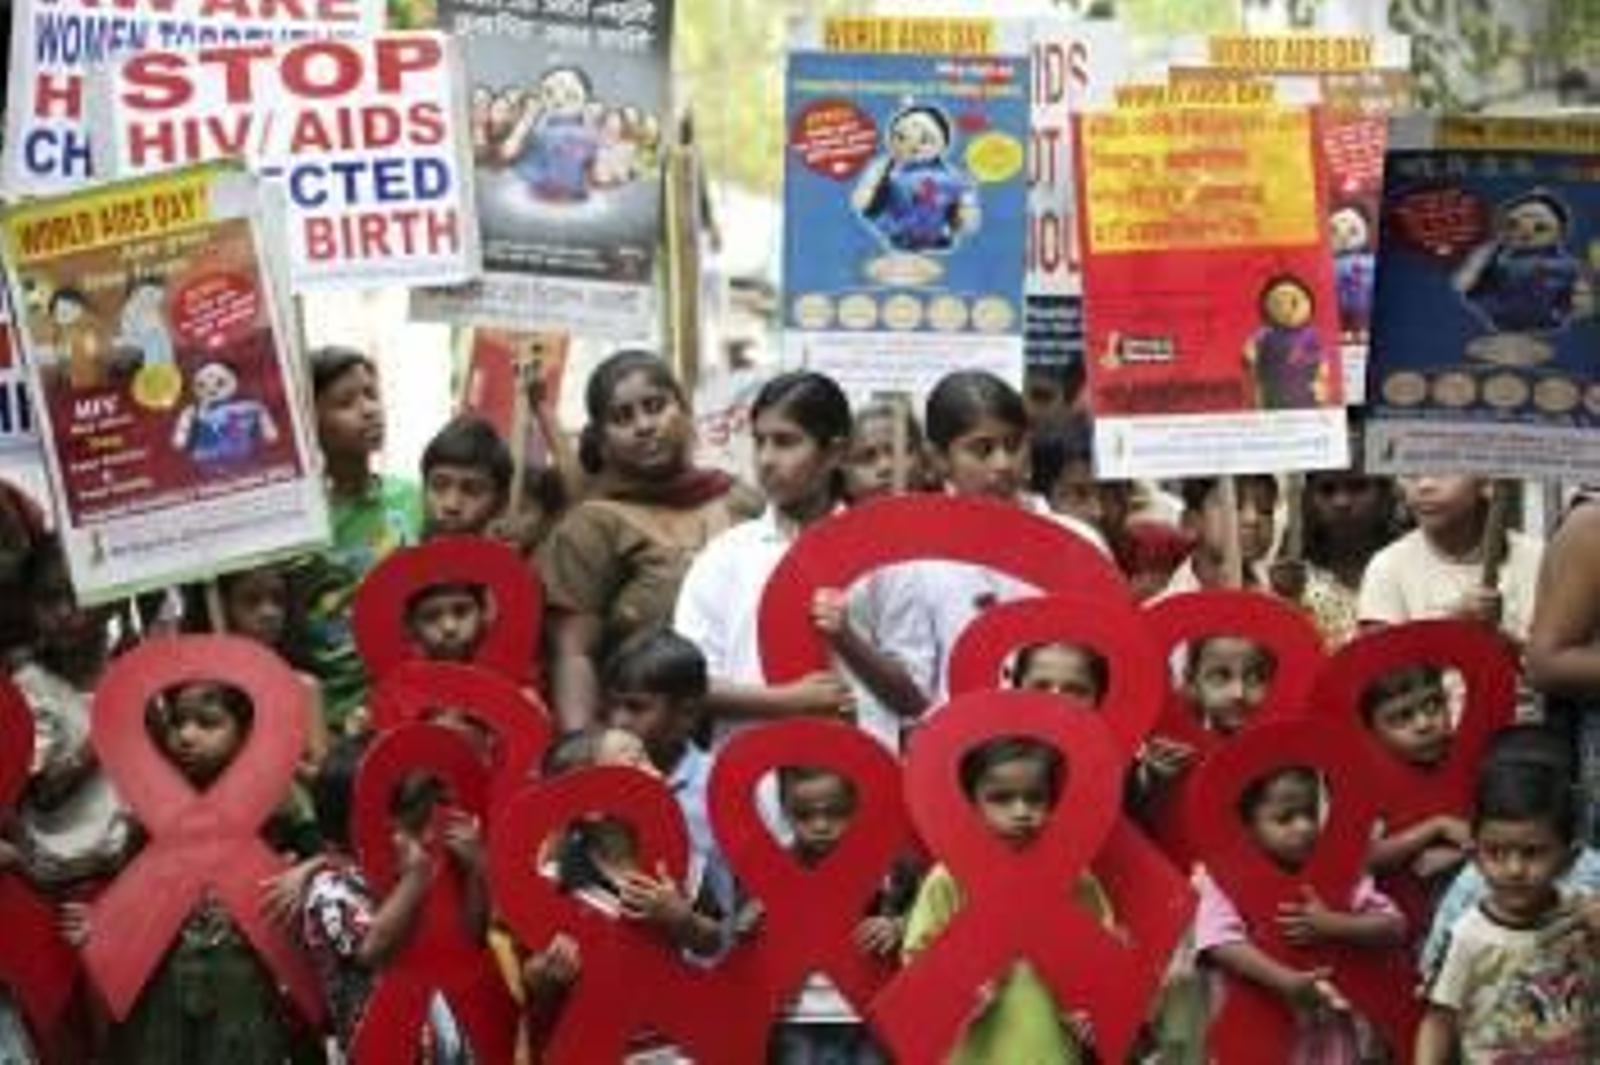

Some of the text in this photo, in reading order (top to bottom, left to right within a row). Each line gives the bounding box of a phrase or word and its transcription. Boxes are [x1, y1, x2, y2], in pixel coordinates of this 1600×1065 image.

[121, 37, 444, 110] STOP
[261, 157, 449, 207] CTED
[18, 207, 97, 256] WORLD
[102, 197, 151, 239] AIDS
[304, 209, 458, 261] BIRTH
